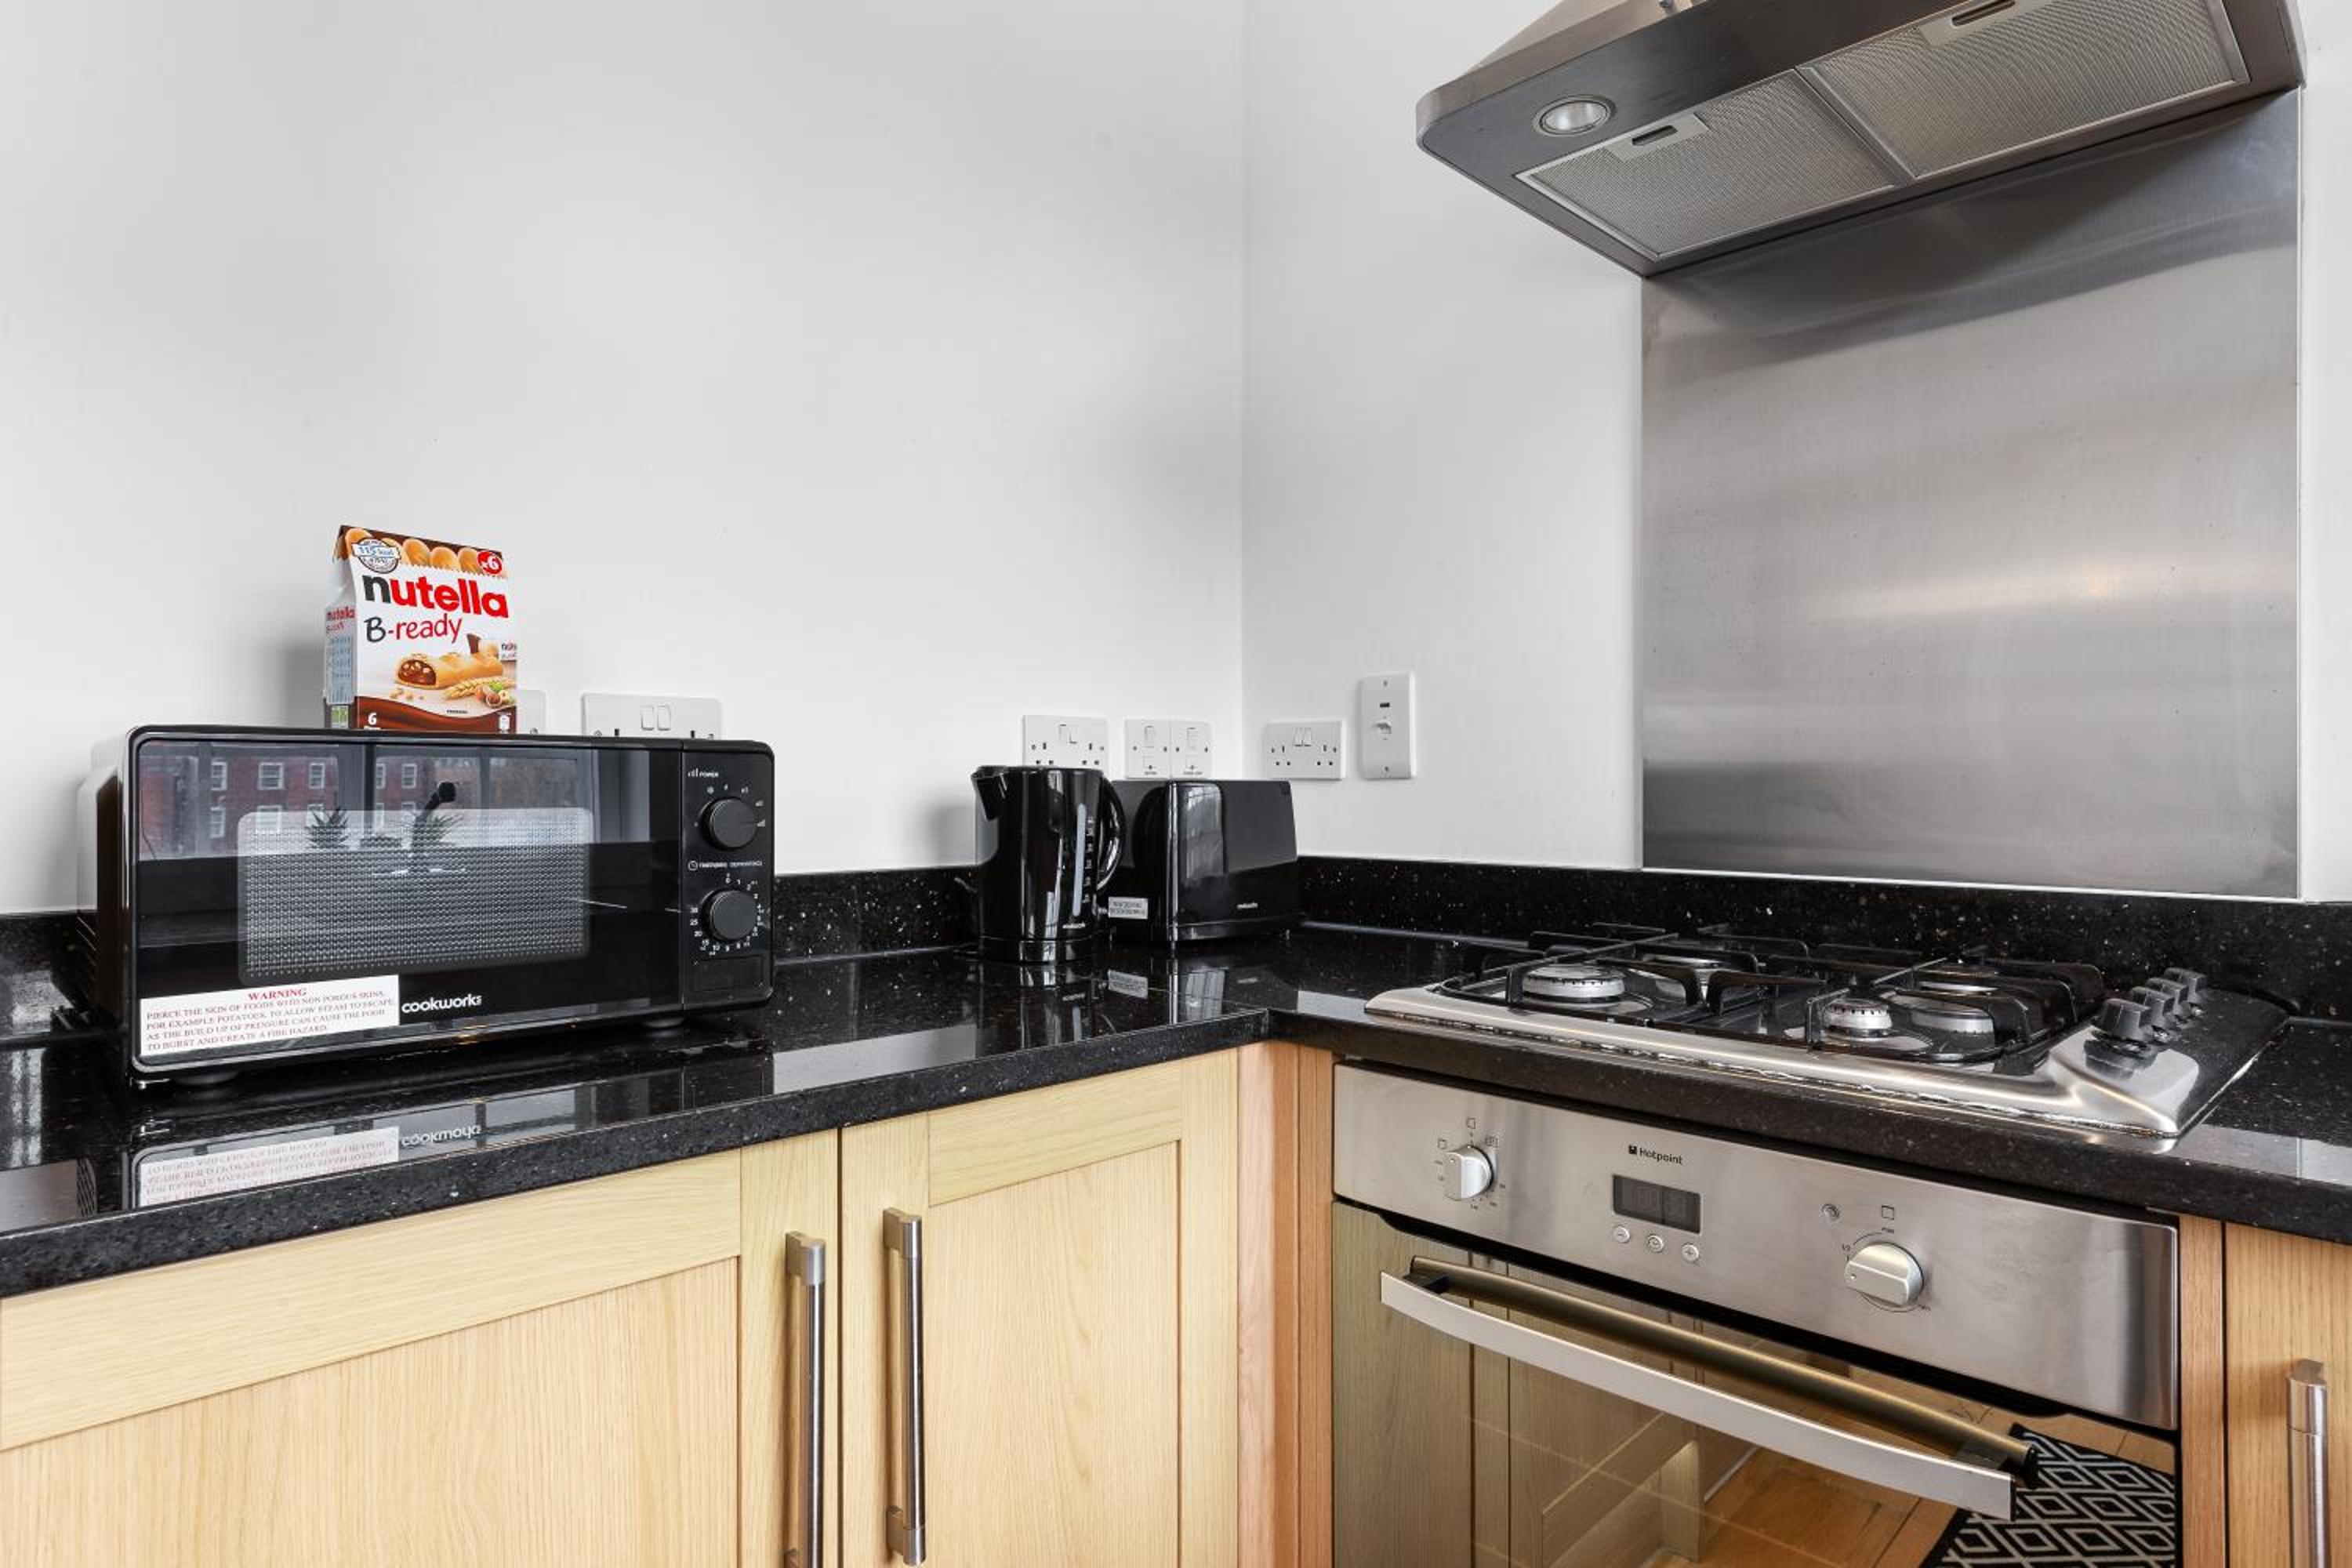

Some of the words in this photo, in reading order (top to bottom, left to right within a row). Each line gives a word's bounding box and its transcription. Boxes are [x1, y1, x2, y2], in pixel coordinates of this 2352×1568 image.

[362, 575, 509, 619] nutella
[364, 613, 463, 644] B-ready
[368, 712, 378, 726] 6
[249, 988, 307, 1000] WARNING
[401, 993, 482, 1014] cookworks
[169, 1018, 216, 1028] EXAMPLE
[1639, 1147, 1683, 1165] Hotpoint
